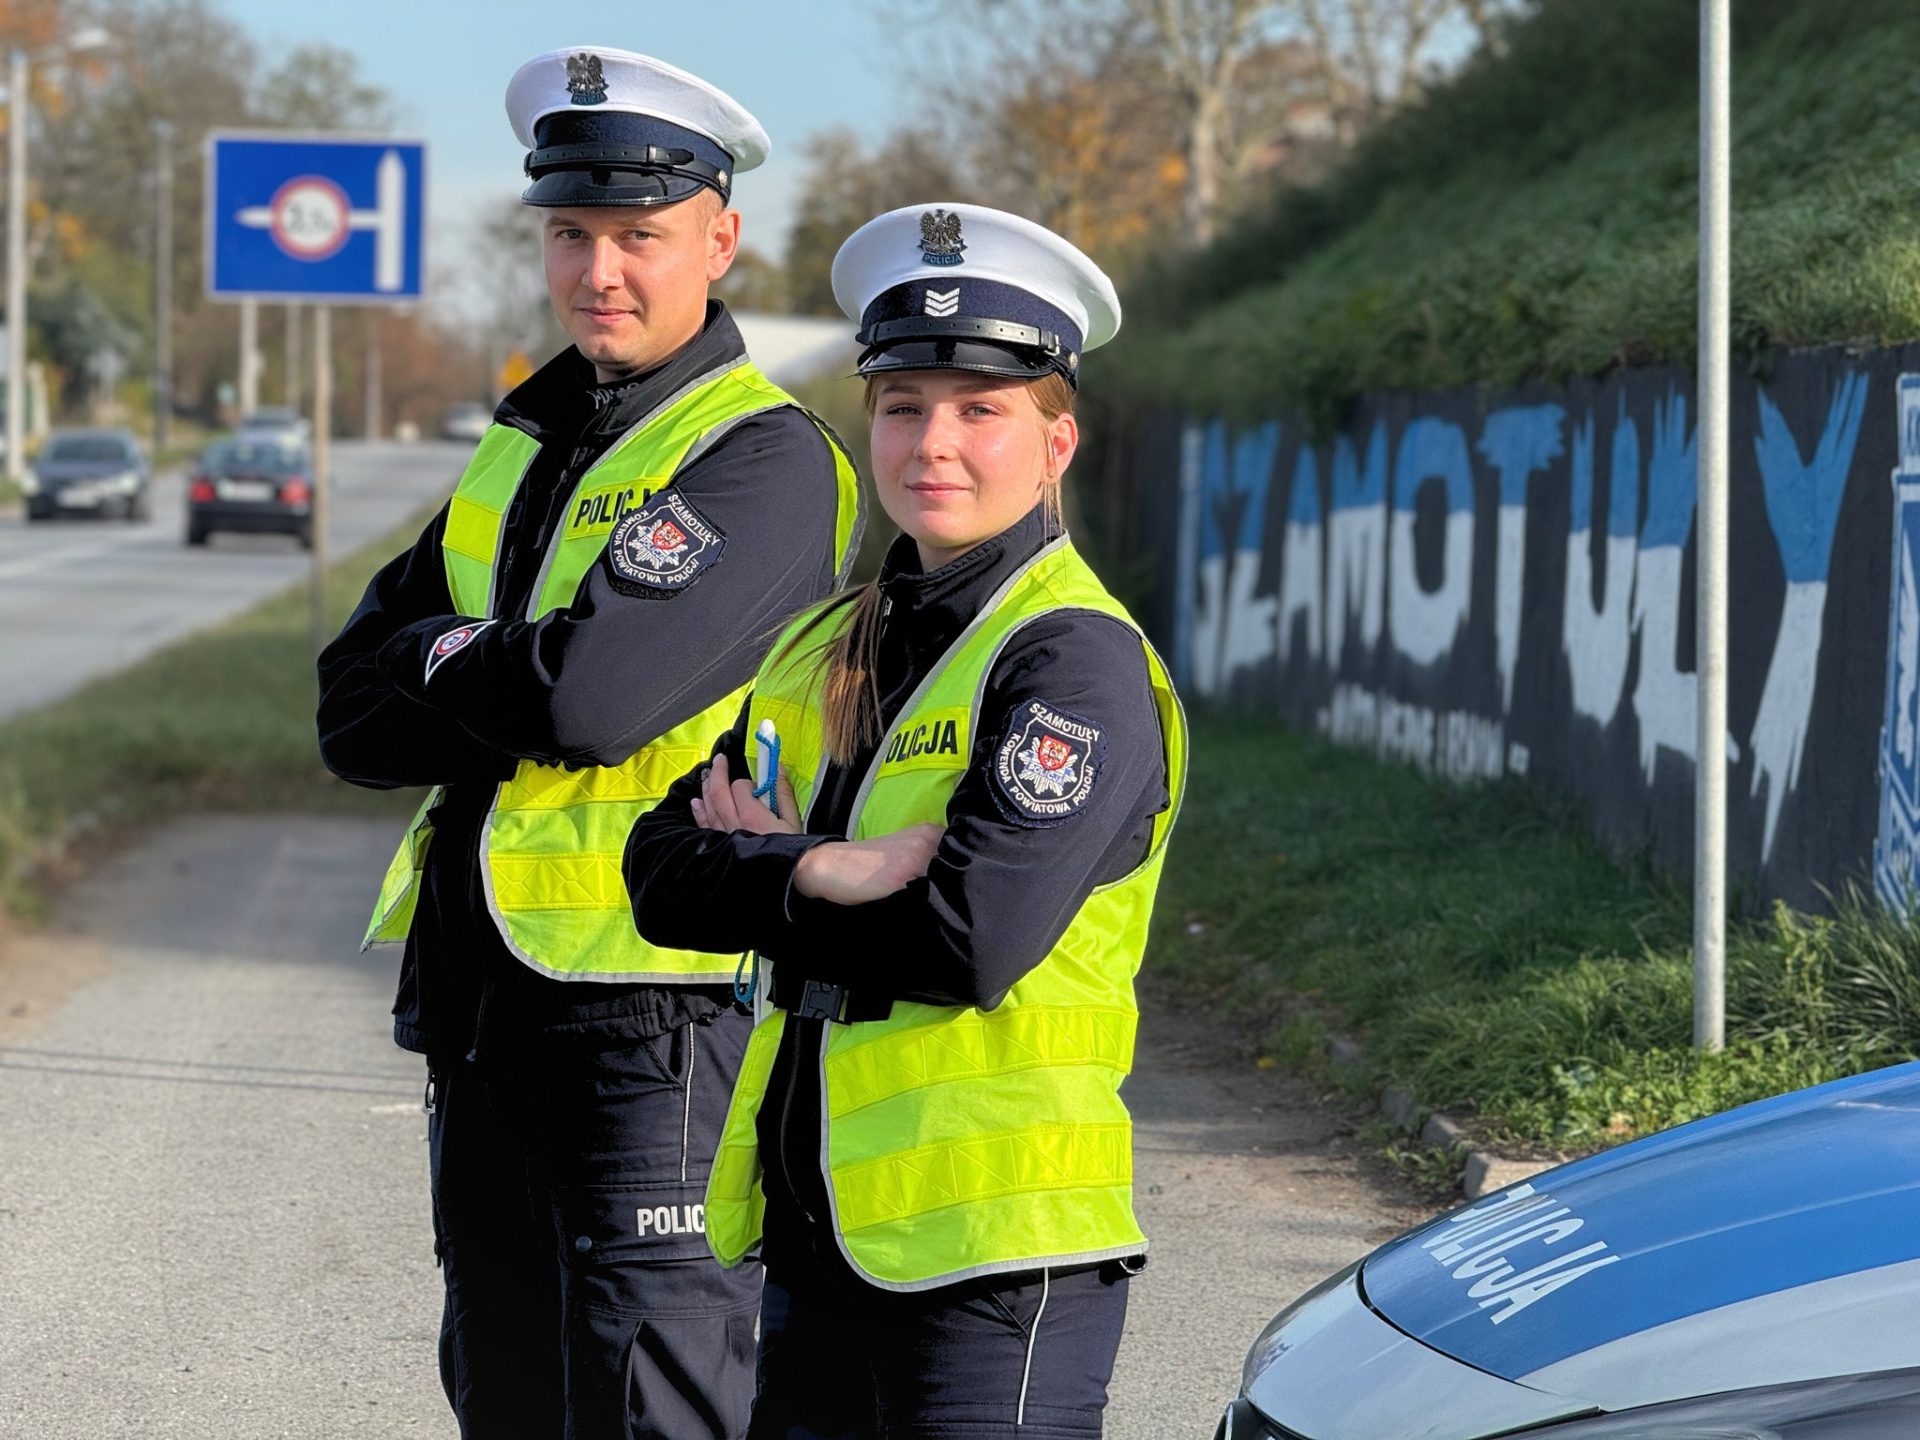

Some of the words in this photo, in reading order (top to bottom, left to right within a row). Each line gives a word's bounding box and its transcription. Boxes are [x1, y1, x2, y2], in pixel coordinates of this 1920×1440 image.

[925, 253, 961, 264] POLICJA
[573, 488, 651, 528] POLIC
[668, 494, 720, 546] SZAMOTUŁY
[614, 510, 650, 545] KOMENDA
[614, 550, 661, 584] POWIATOWA
[667, 558, 699, 584] POLICJI
[1029, 703, 1100, 742] SZAMOTUŁY
[885, 720, 958, 763] OLICJA
[999, 733, 1021, 783] KOMENDA
[1009, 786, 1071, 813] POWIATOWA
[1073, 765, 1094, 806] POLICJI
[637, 1204, 705, 1236] POLIC
